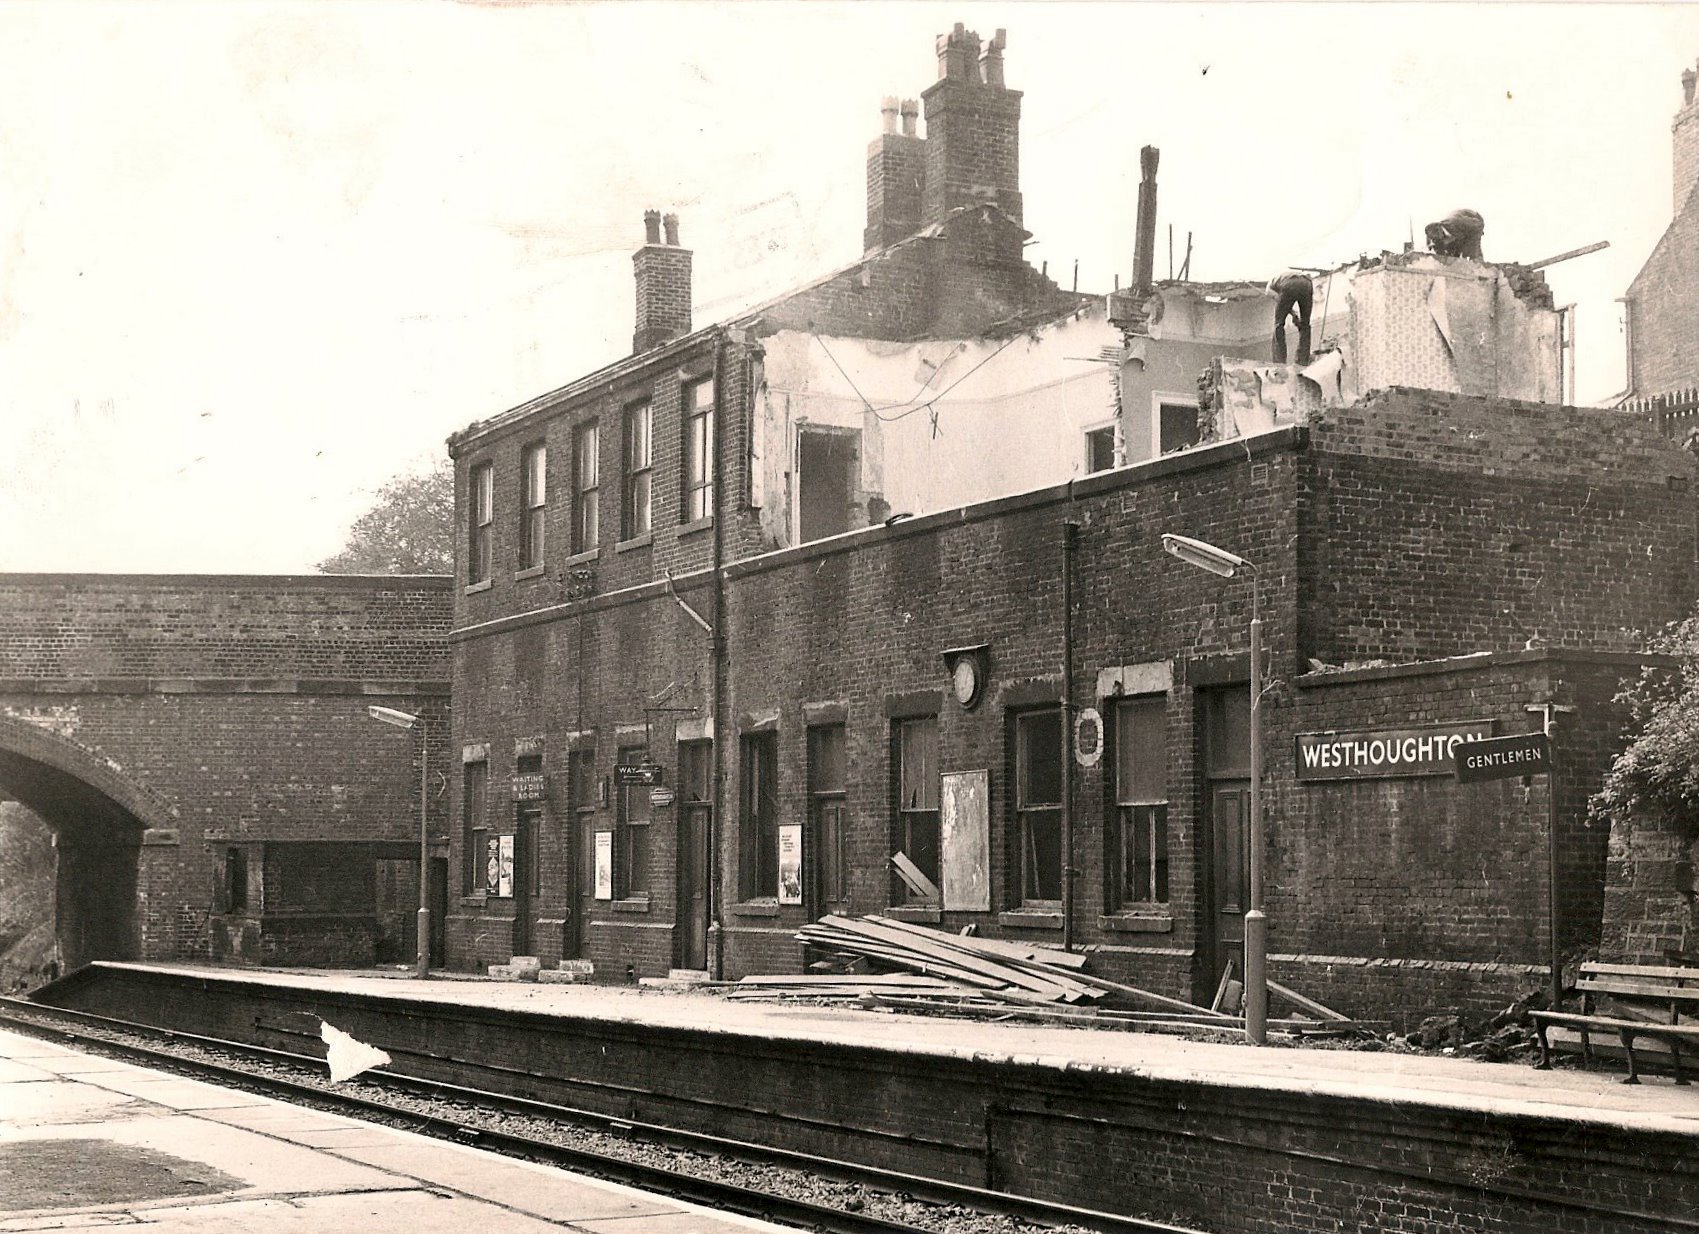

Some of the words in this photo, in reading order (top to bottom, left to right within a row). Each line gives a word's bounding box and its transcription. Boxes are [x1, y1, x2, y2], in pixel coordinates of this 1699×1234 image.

[1466, 747, 1542, 769] GENTLEMEN
[512, 775, 544, 783] WAITING
[520, 783, 544, 791] LADIES
[518, 792, 540, 800] ROOM
